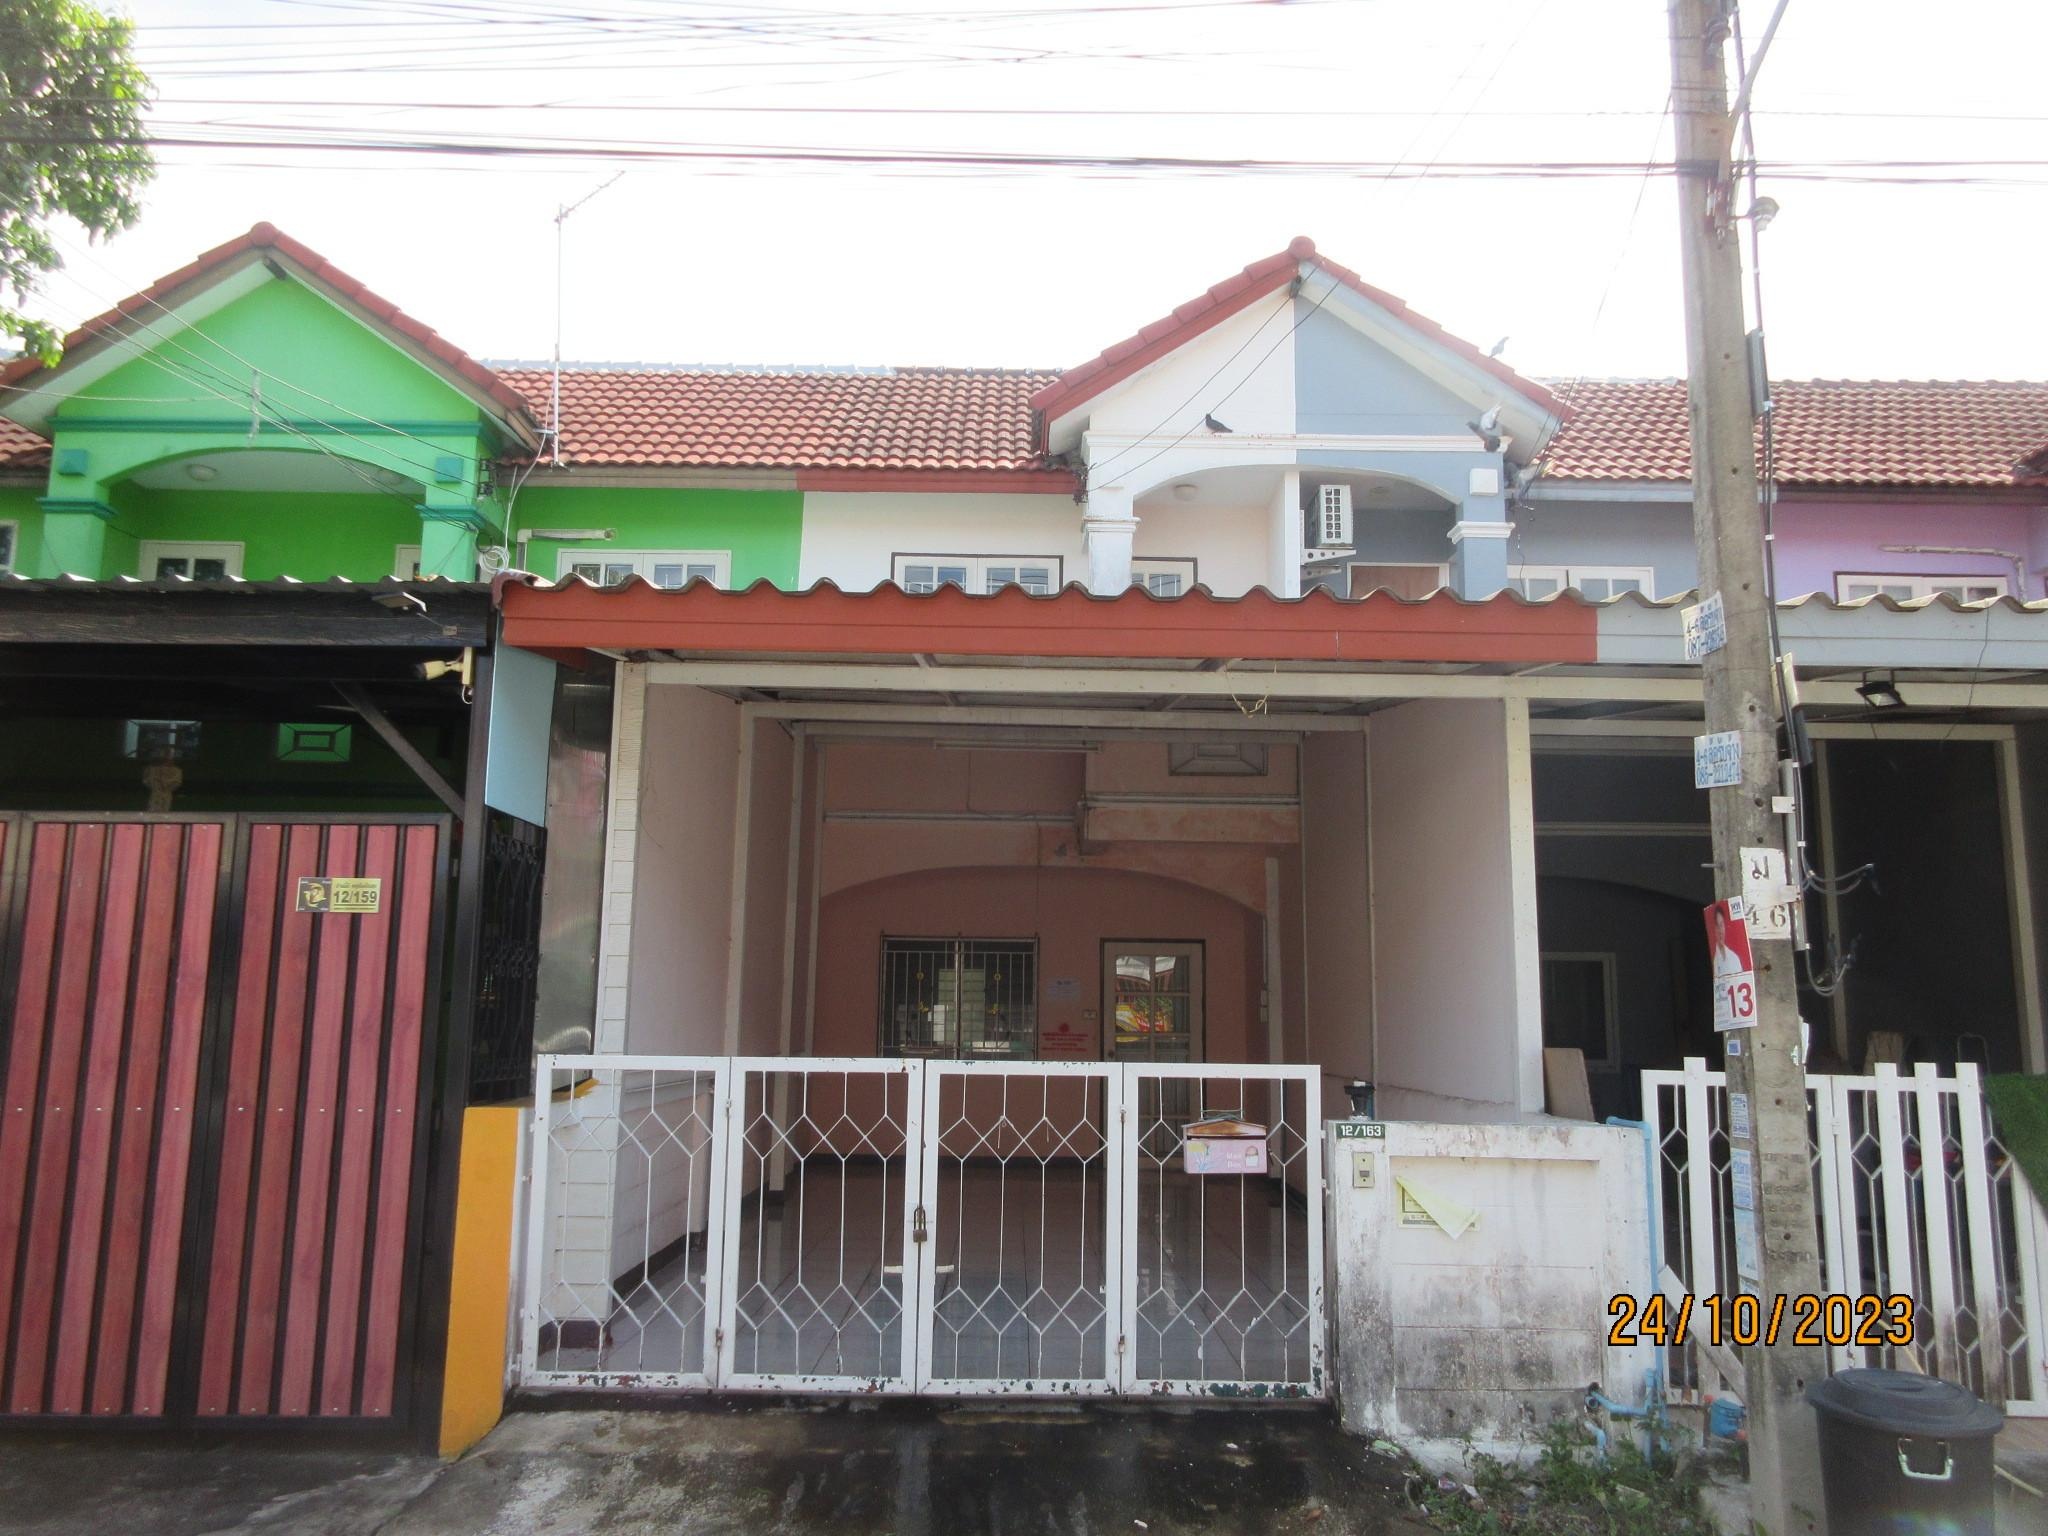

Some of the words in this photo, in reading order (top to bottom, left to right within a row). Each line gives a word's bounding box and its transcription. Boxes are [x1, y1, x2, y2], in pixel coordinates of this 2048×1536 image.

[333, 890, 377, 903] 12/159
[1728, 982, 1753, 1018] 13
[1341, 1125, 1381, 1137] 12/163
